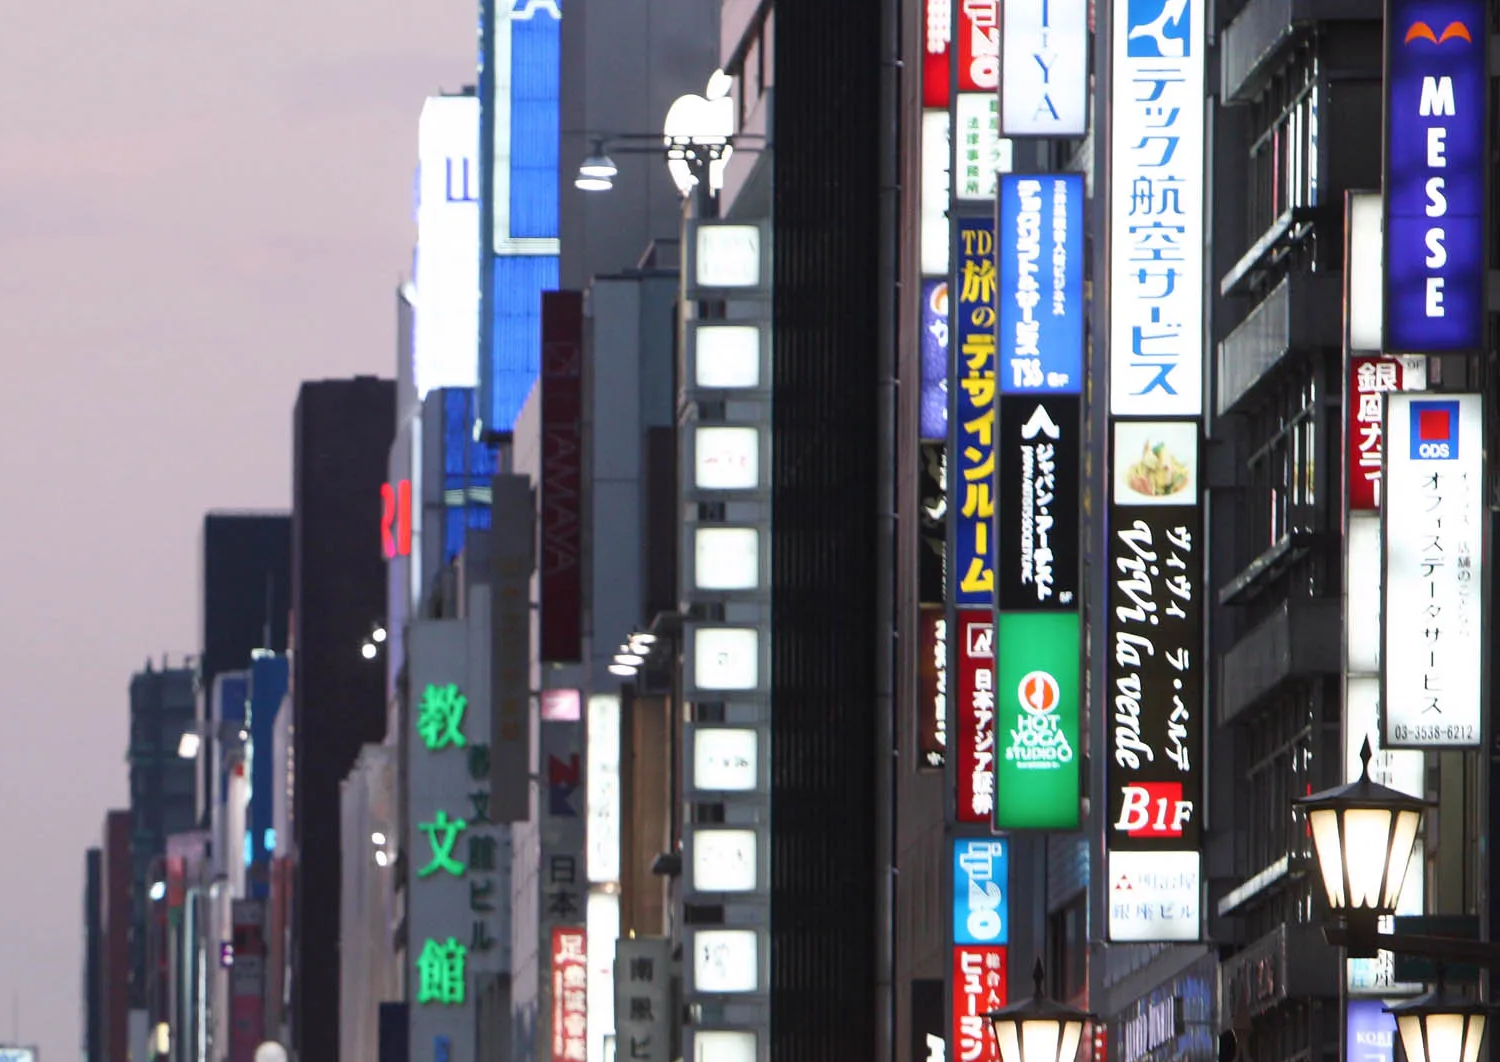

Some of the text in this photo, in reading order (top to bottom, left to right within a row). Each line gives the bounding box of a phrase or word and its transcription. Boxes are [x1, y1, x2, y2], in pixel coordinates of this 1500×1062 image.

[1129, 69, 1187, 396] テック航空サービス
[1419, 75, 1455, 318] MESSE
[960, 258, 996, 592] 旅のデザインルーム
[1419, 444, 1450, 459] ODS
[1421, 472, 1445, 714] オフィスデータサービス
[1115, 629, 1155, 669] la
[1011, 728, 1069, 748] YOGA
[1017, 714, 1061, 732] HOT
[1115, 672, 1155, 771] verde
[1394, 724, 1474, 741] 03-3538-6212
[416, 683, 468, 1005] 教文館
[1115, 786, 1192, 832] B1F
